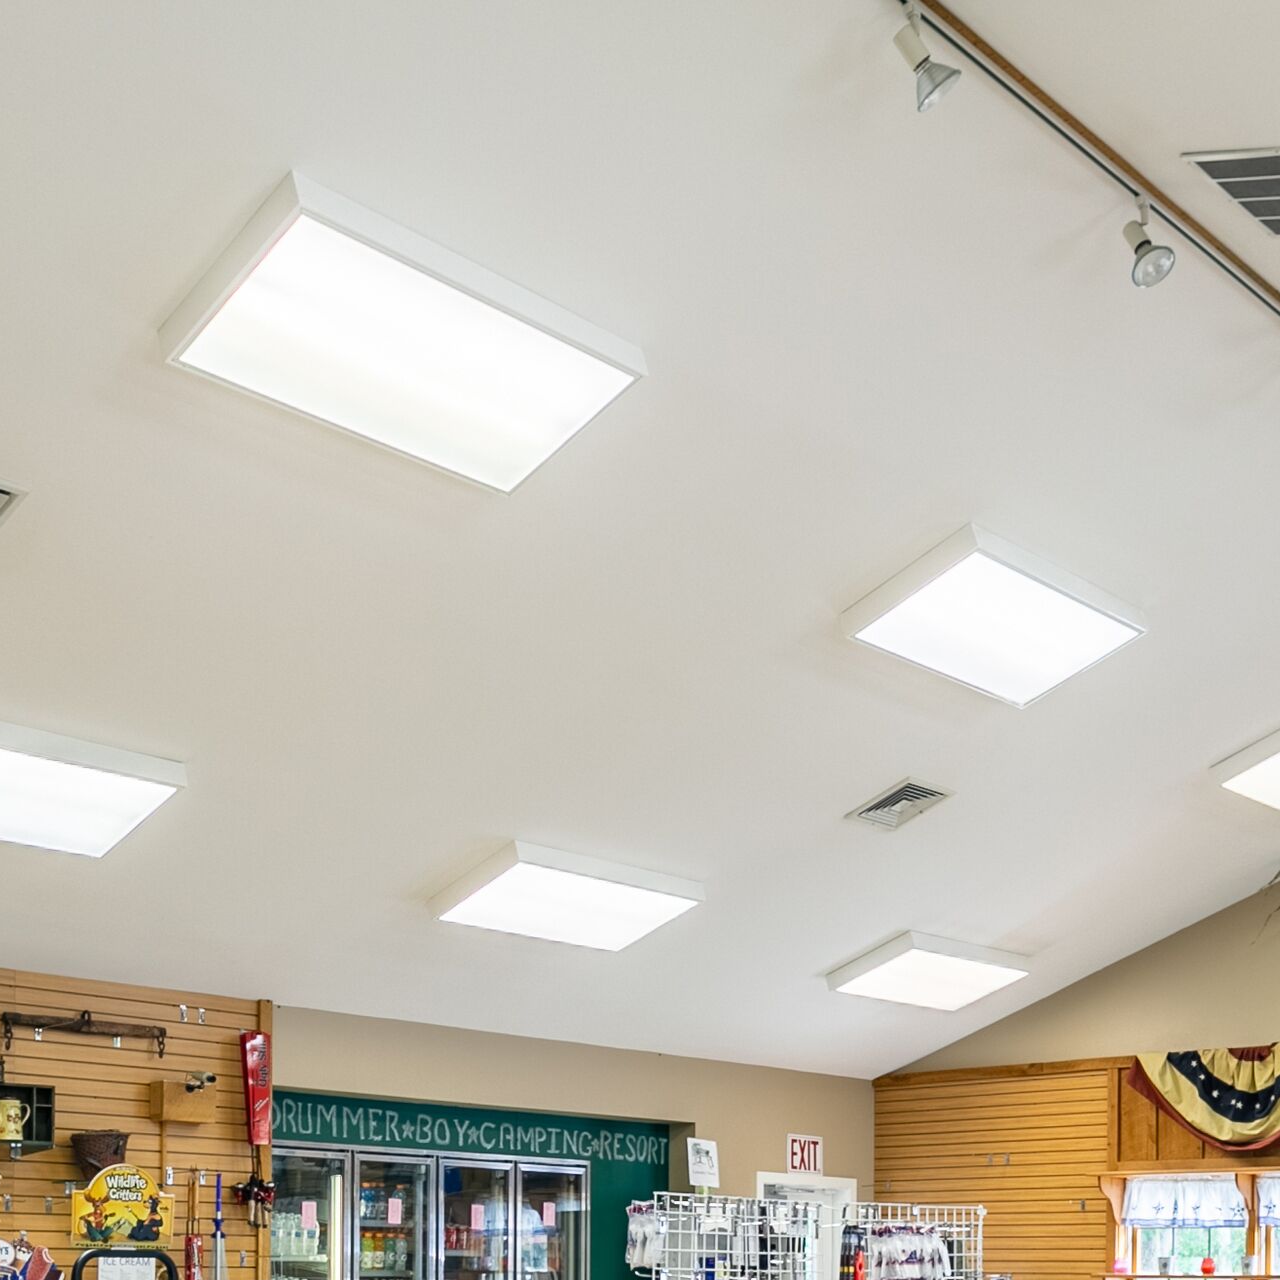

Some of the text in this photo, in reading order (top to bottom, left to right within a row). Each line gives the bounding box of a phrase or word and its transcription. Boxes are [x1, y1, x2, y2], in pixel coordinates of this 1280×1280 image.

[416, 1114, 470, 1147] BOY
[479, 1122, 593, 1156] CAMPING
[598, 1130, 669, 1165] RESORT
[791, 1138, 819, 1171] EXIT
[105, 1174, 147, 1191] Wildlife
[108, 1189, 144, 1202] Critters
[103, 1257, 151, 1266] ICE CREAM
